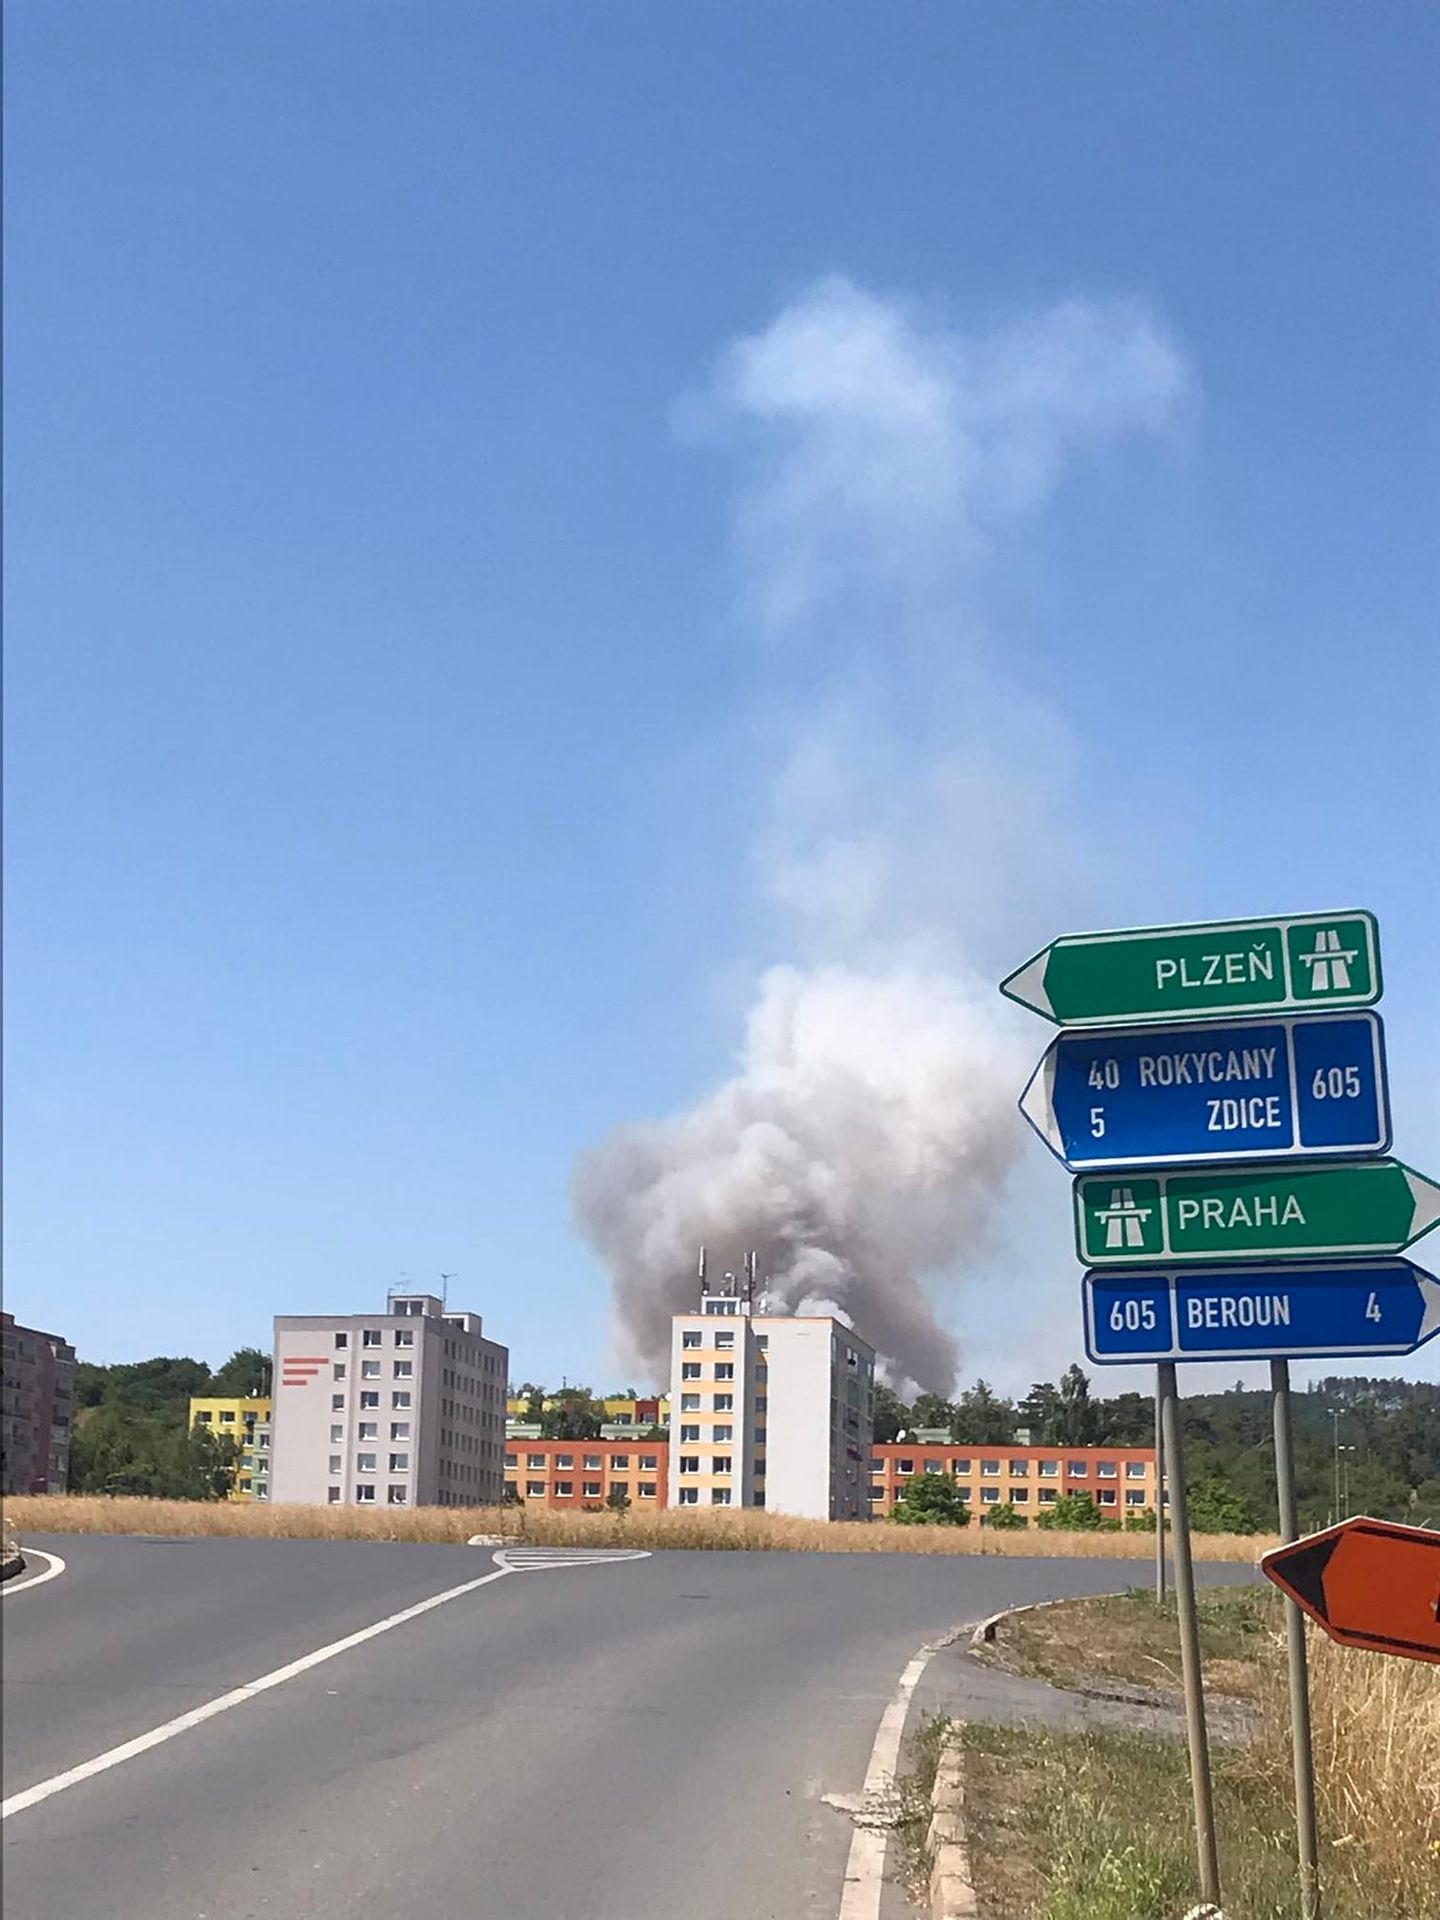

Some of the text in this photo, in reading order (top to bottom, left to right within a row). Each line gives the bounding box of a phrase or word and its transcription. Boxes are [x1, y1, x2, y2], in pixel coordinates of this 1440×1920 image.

[1155, 942, 1274, 990] PLZEŇ
[1088, 1047, 1277, 1091] 40 ROKYCANY
[1312, 1066, 1361, 1099] 605
[1090, 1096, 1281, 1138] 5 ZDICE
[1178, 1195, 1306, 1230] PRAHA
[1109, 1300, 1156, 1330] 605
[1187, 1292, 1382, 1328] BEROUN 4
